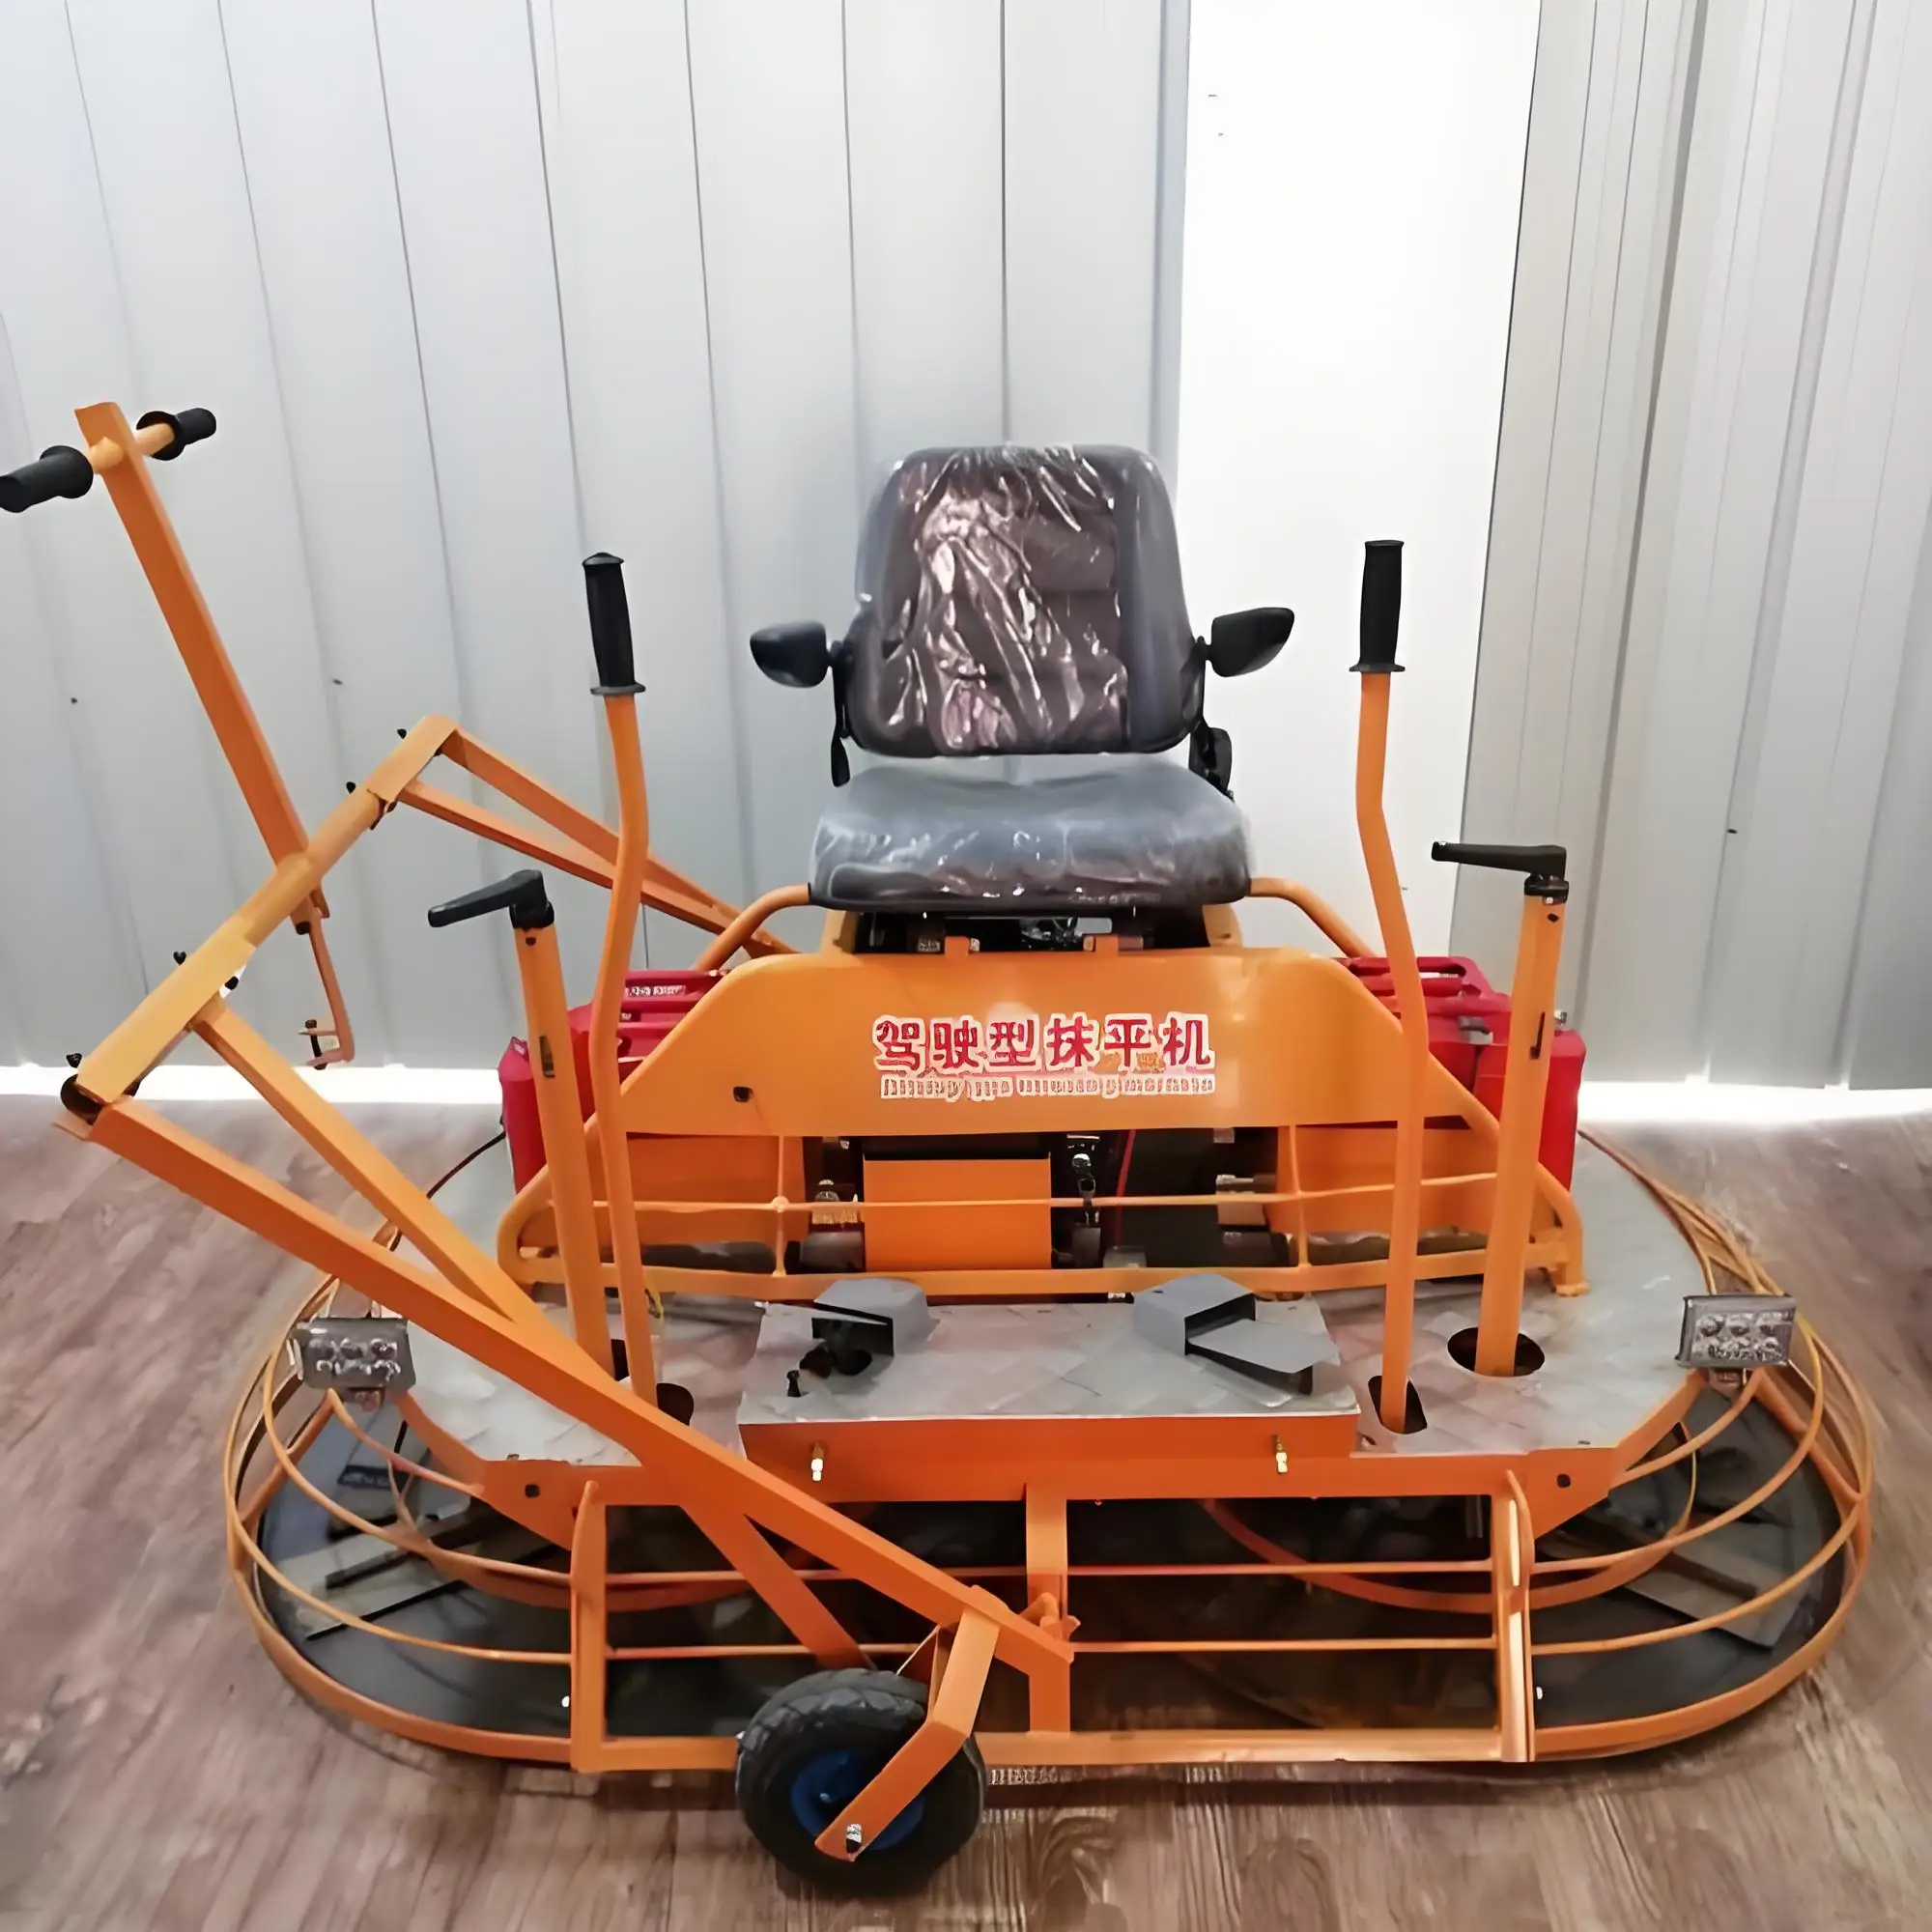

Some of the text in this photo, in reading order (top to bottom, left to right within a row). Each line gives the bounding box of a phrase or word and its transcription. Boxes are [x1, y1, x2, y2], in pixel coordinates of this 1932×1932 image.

[874, 1013, 1213, 1068] 驾驶型抹平机
